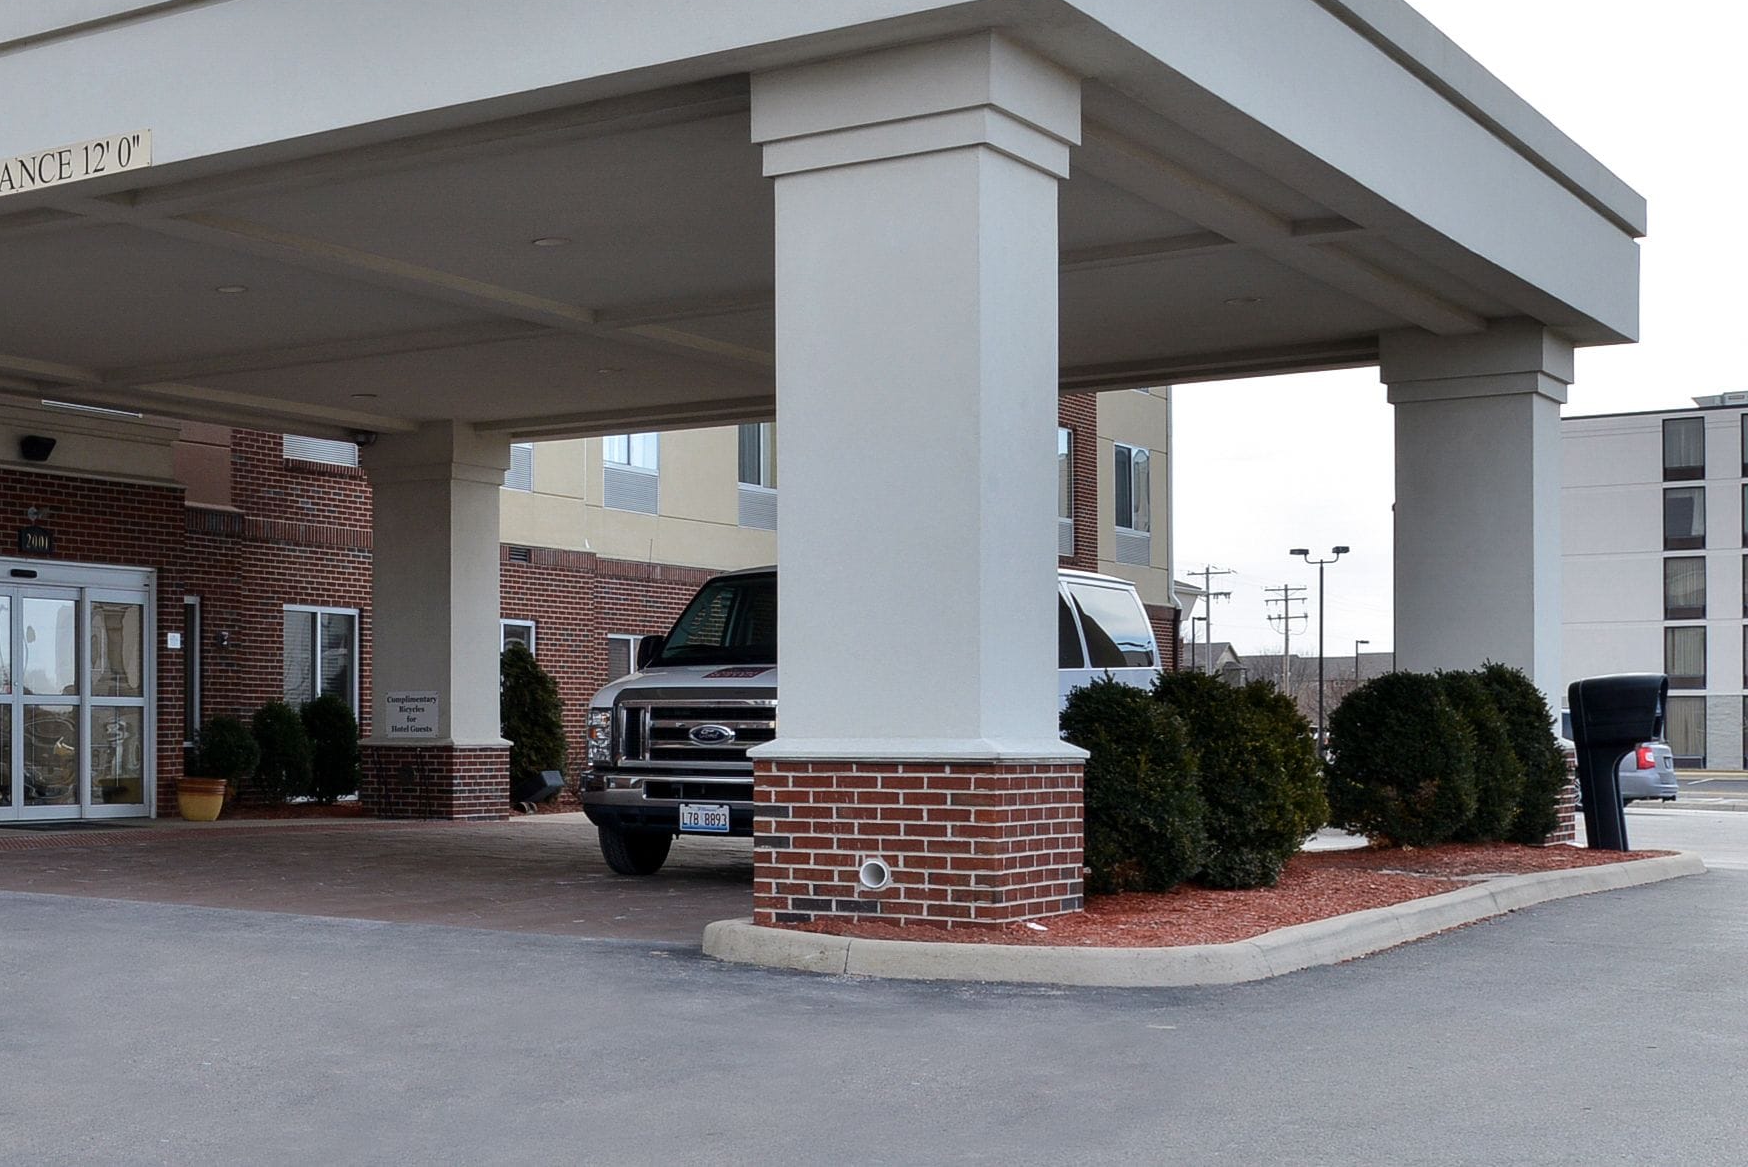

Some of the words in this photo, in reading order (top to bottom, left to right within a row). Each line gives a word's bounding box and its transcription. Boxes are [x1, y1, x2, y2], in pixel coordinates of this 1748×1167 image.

[82, 140, 110, 176] 12'
[386, 695, 437, 705] Complimentary
[399, 705, 425, 714] Bicycles
[406, 715, 417, 723] for
[391, 725, 409, 733] Hotel
[410, 725, 433, 733] Guests
